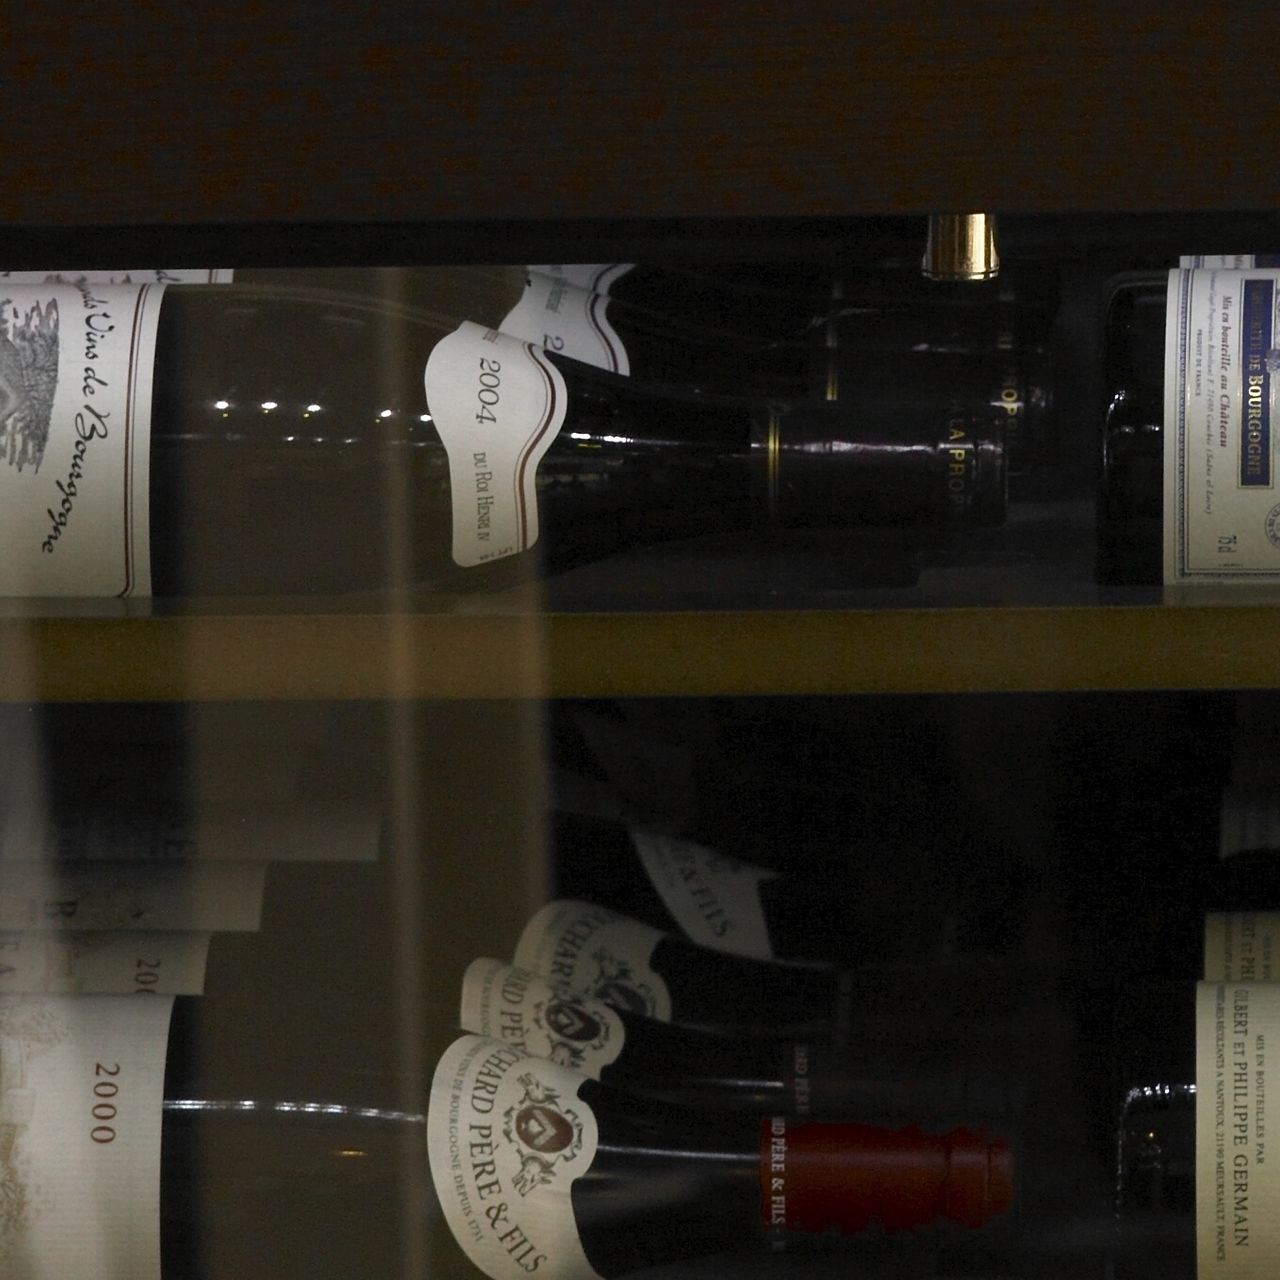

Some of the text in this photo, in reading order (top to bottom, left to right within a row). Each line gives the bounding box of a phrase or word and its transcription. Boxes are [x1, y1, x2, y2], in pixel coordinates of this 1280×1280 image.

[1220, 325, 1232, 372] bouteille
[475, 357, 502, 425] 2004
[1220, 374, 1229, 390] au
[41, 312, 116, 555] Vins de Bourgogne
[1219, 393, 1231, 448] Château
[1247, 375, 1264, 475] BOURGOGNE
[1232, 1041, 1246, 1057] ET
[1255, 1053, 1266, 1067] EN
[90, 1062, 121, 1146] 2000
[1232, 1060, 1250, 1147] PHILIPPE
[1255, 1069, 1266, 1139] BOUTEILLES
[449, 1092, 463, 1172] BOURGOGNE
[771, 1137, 789, 1172] PÈRE
[1255, 1142, 1266, 1165] PAR
[452, 1174, 473, 1217] DEPUIS
[468, 1120, 549, 1274] PÈRE & FILS
[771, 1176, 785, 1192] &
[771, 1195, 787, 1225] FILS
[1232, 1152, 1251, 1248] GERMAIN
